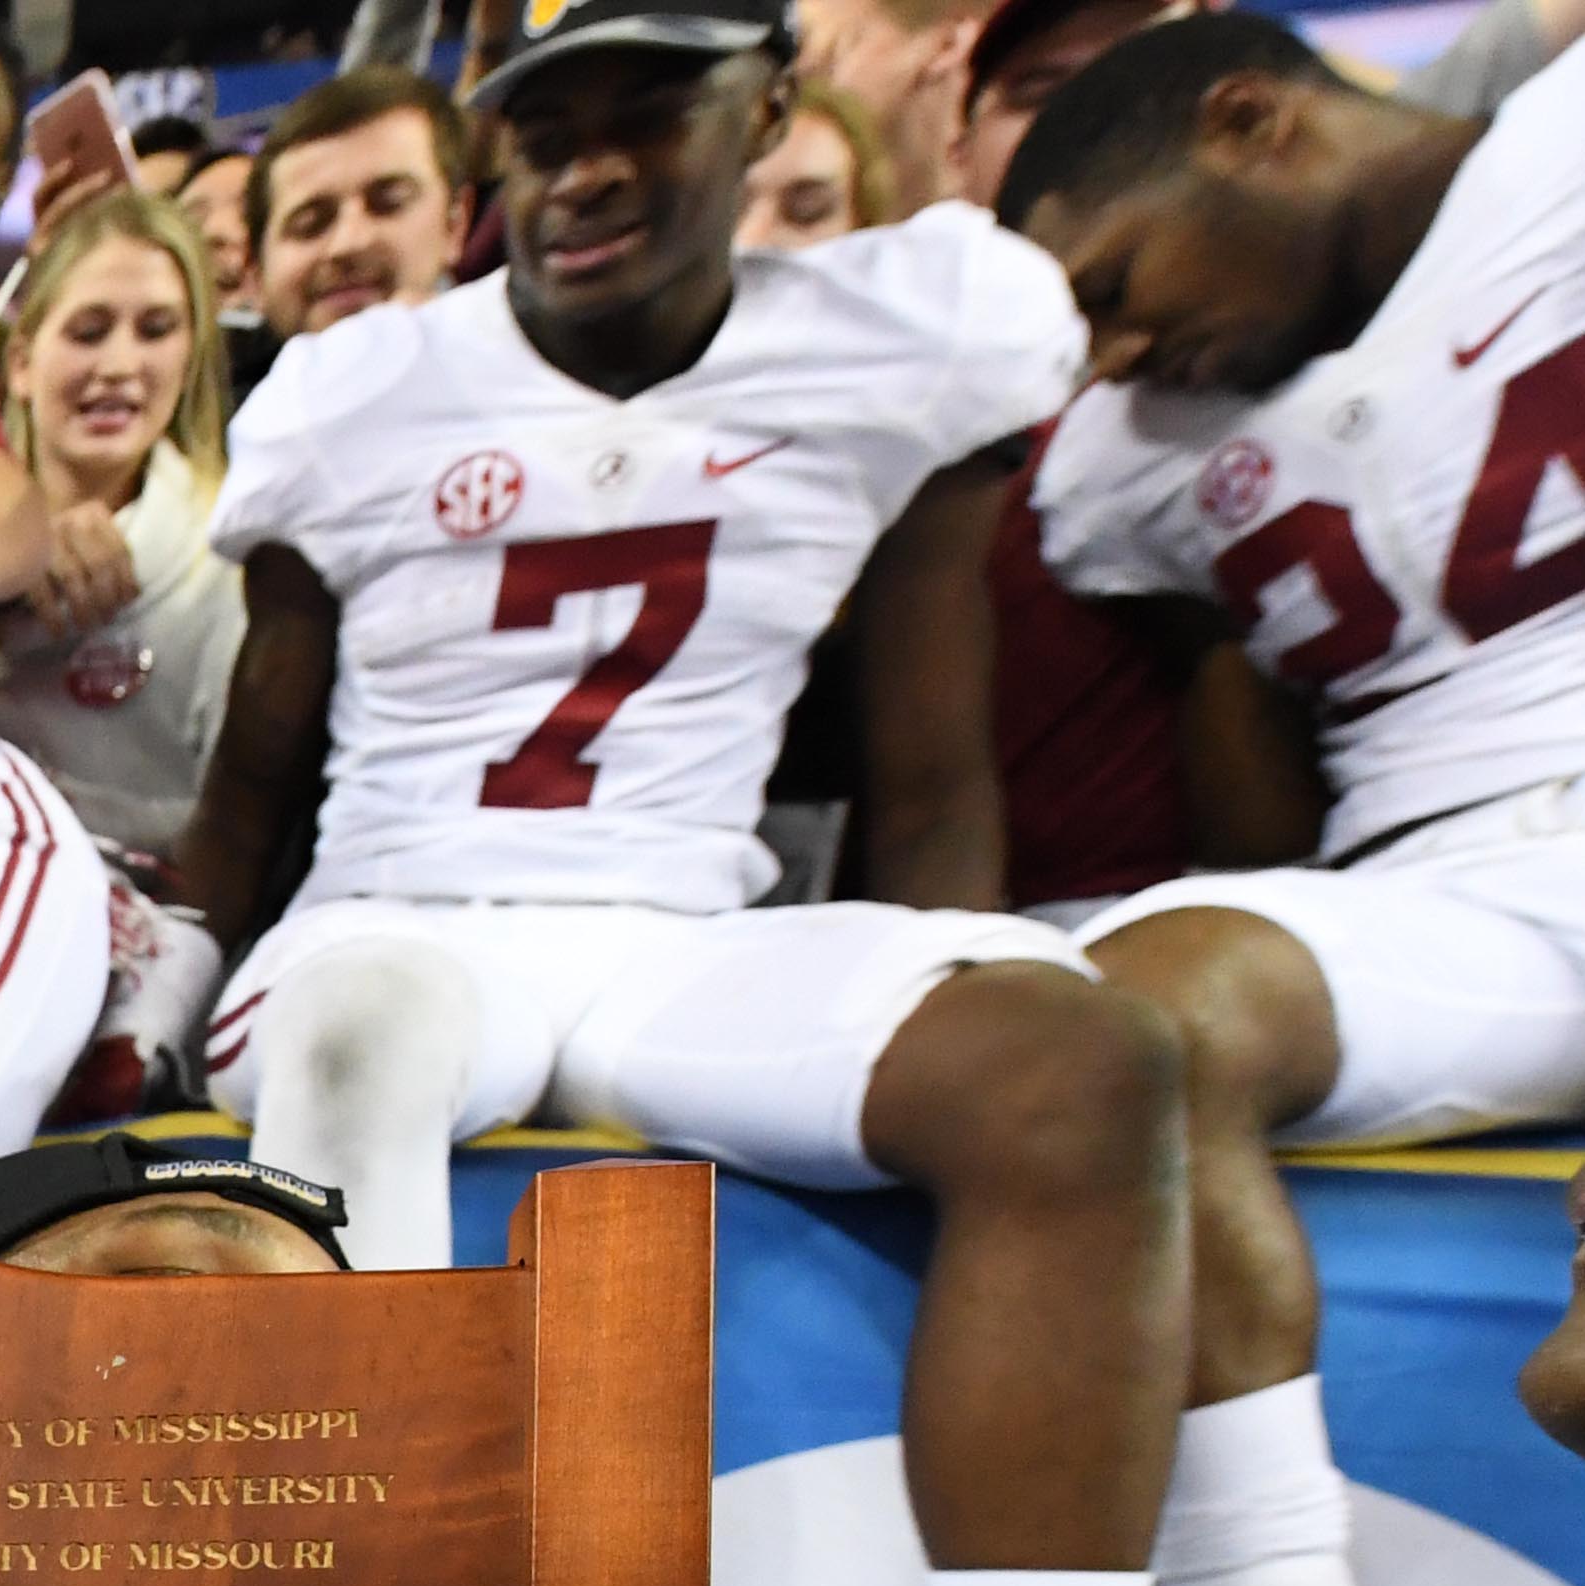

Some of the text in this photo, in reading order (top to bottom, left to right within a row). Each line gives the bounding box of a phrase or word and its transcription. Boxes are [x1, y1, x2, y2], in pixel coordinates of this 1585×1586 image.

[435, 450, 524, 537] SEC
[478, 519, 718, 808] 7
[44, 1417, 100, 1448] OF
[113, 1408, 360, 1445] MISSISSIPPI
[7, 1478, 128, 1511] STATE
[141, 1473, 395, 1507] UNIVERSITY
[59, 1541, 115, 1571] OF
[128, 1539, 336, 1573] MISSOURI
